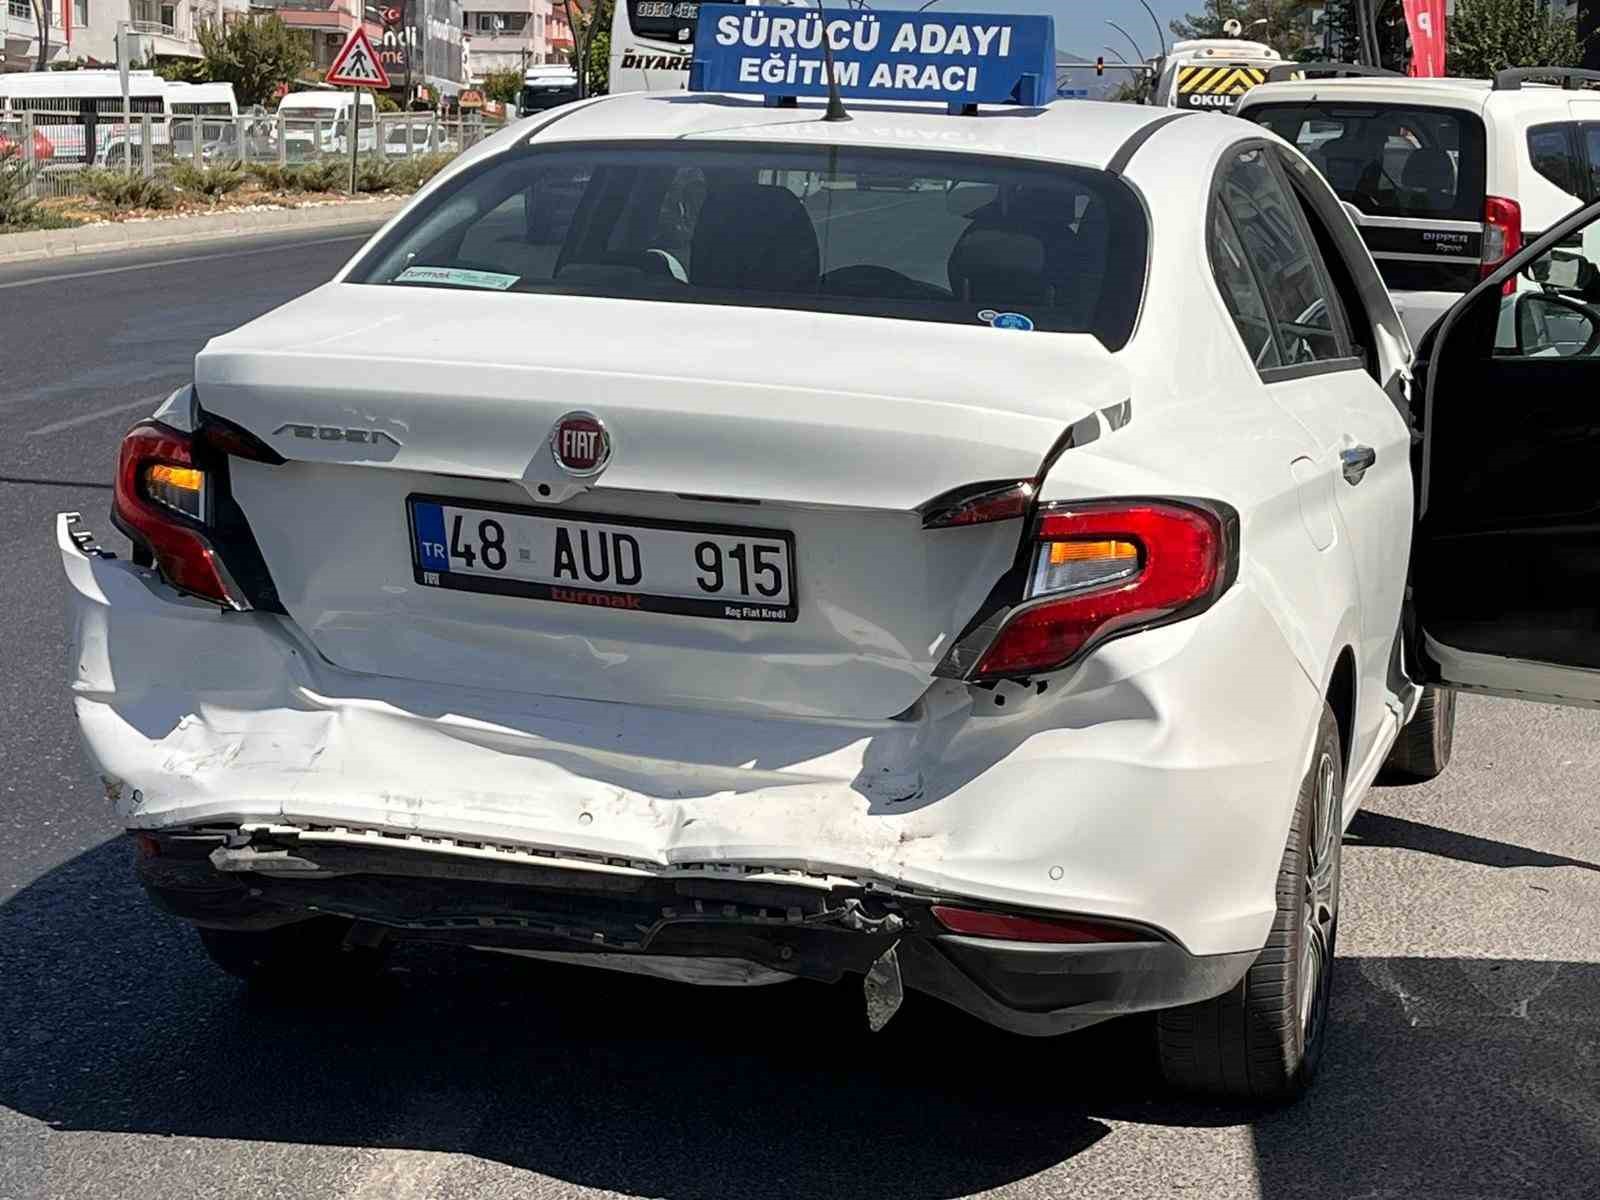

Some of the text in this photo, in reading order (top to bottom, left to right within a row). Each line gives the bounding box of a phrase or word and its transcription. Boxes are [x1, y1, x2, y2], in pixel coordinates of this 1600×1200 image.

[715, 10, 1012, 57] SÜRÜCÜ ADAYI
[868, 63, 978, 92] ARACI
[1189, 94, 1235, 107] OKUL
[563, 429, 599, 460] FIAT
[422, 514, 782, 598] TR 48 AUD 915
[551, 586, 642, 609] turmak
